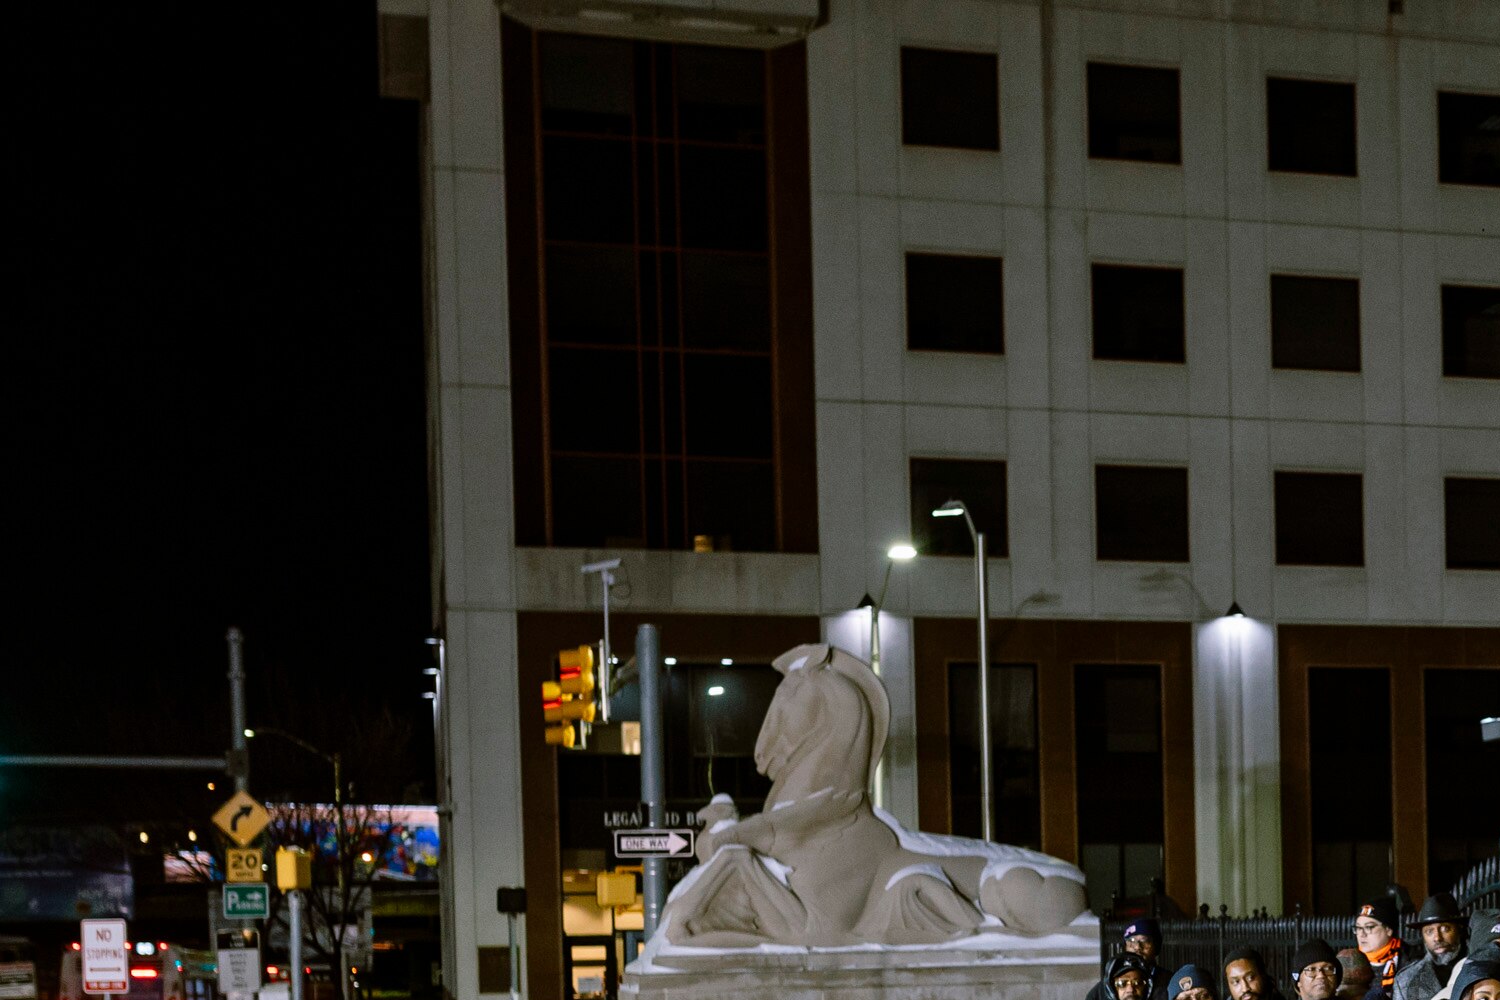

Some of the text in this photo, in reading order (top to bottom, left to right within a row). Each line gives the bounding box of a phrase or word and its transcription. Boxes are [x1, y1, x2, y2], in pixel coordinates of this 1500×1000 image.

[625, 839, 669, 849] ONE WAY
[231, 853, 258, 870] 20
[96, 930, 112, 941] NO
[87, 948, 123, 960] STOPPING
